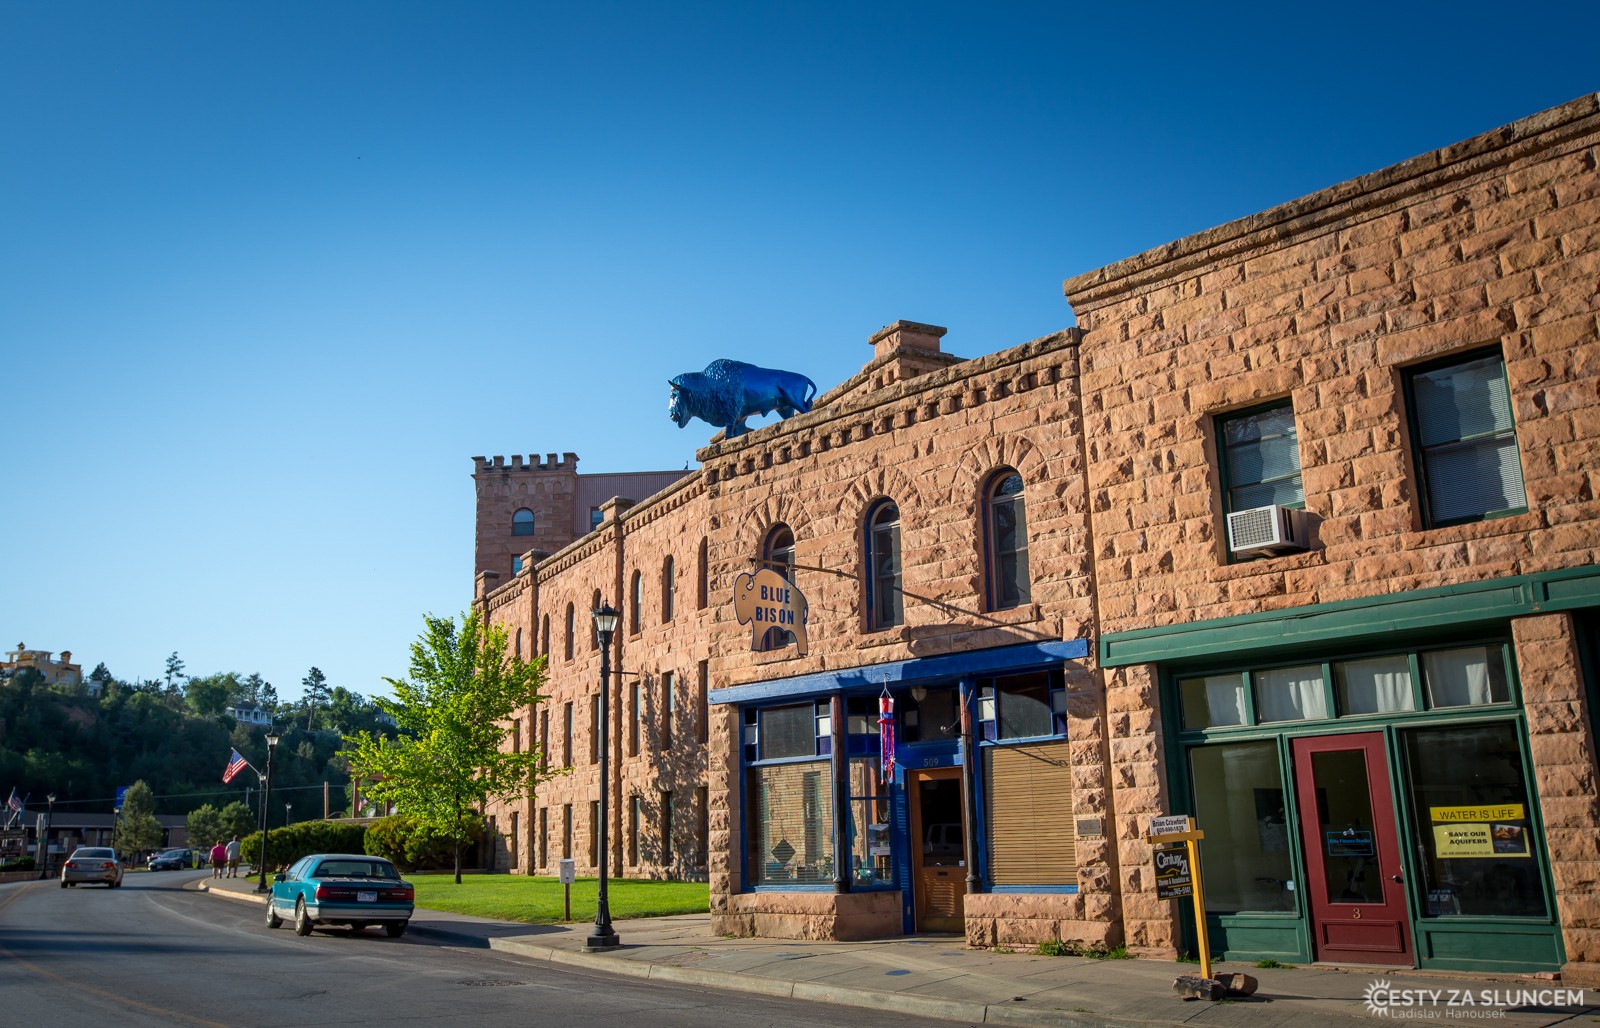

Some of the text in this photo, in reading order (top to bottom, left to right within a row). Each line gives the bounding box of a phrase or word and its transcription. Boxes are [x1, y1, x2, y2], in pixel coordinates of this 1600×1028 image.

[761, 585, 790, 604] BLUE
[755, 606, 794, 625] BISON
[923, 757, 939, 767] 509
[1439, 809, 1515, 820] WATER IS LIFE
[1156, 852, 1182, 868] Century
[1180, 860, 1189, 875] 21
[1353, 908, 1361, 919] 3
